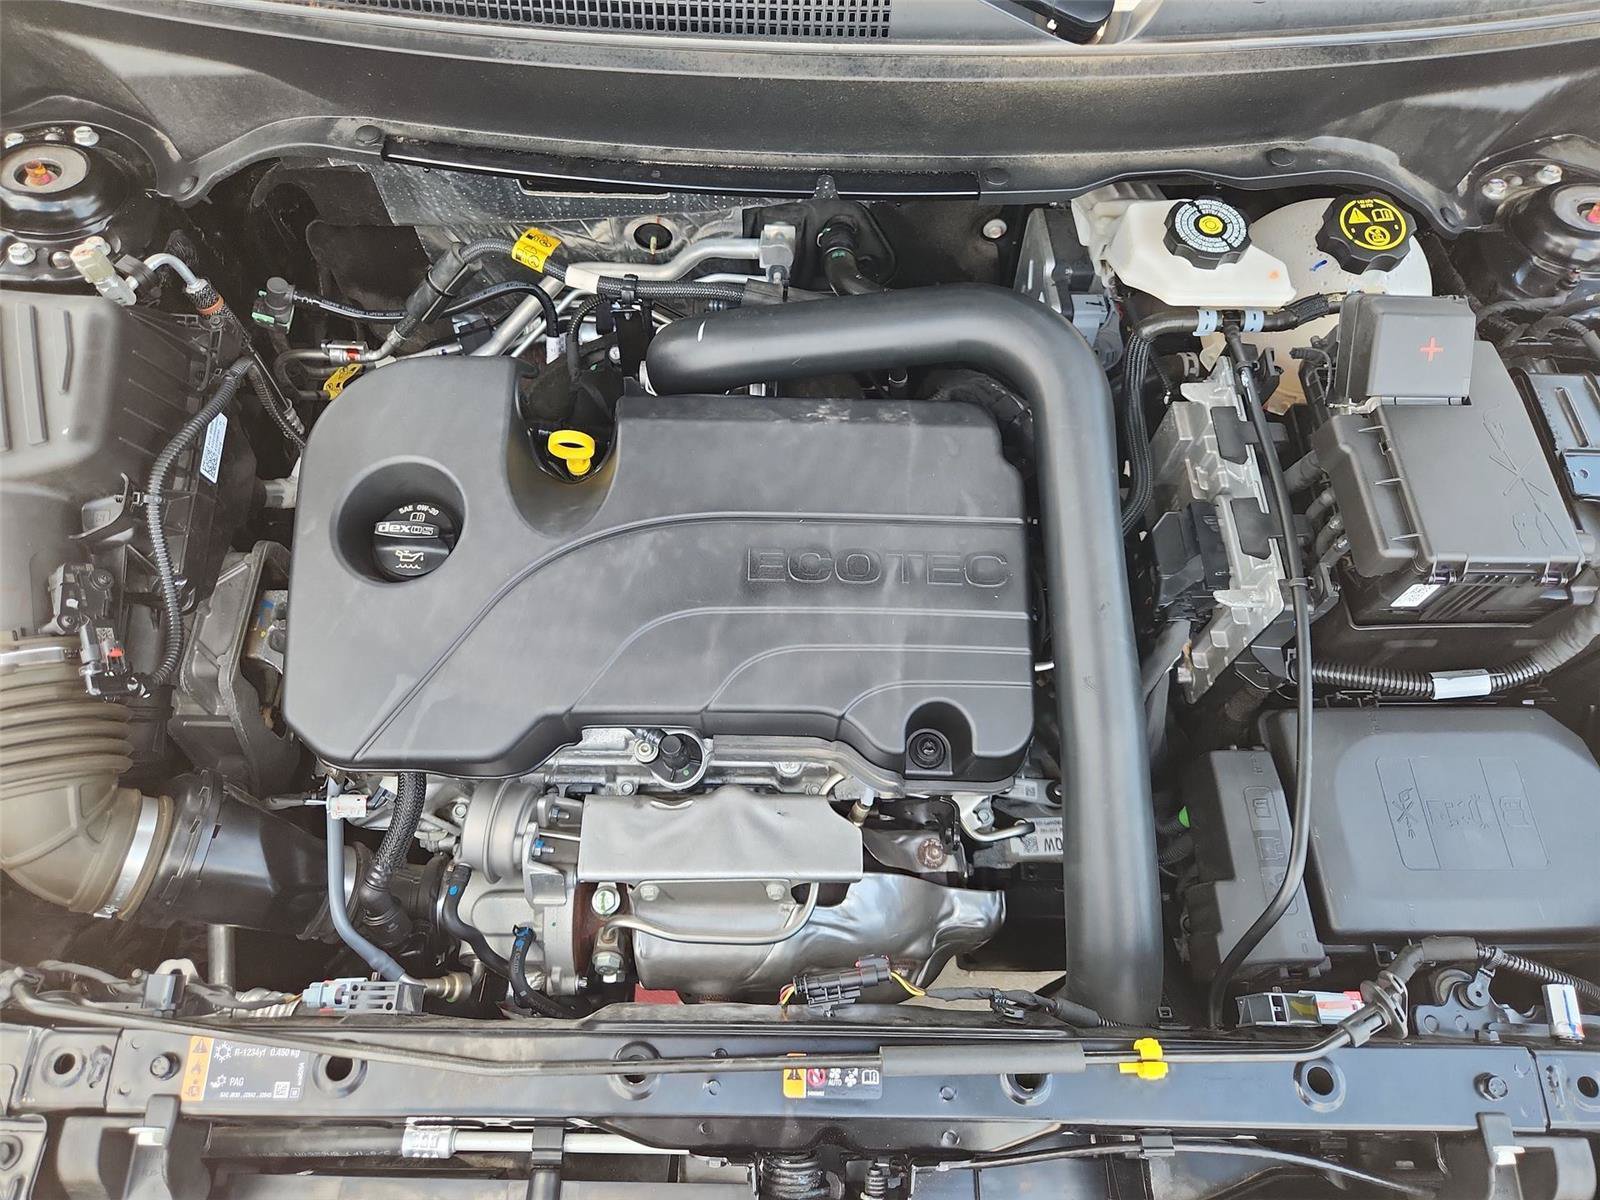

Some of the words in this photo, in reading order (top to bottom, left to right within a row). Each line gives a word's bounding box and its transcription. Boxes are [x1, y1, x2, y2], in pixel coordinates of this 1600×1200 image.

[398, 504, 414, 515] SAE
[416, 504, 440, 516] 0W-20
[377, 522, 434, 536] dexos
[747, 546, 1009, 589] ECOTEC
[229, 1076, 245, 1087] PAG
[827, 1079, 843, 1087] AUTO
